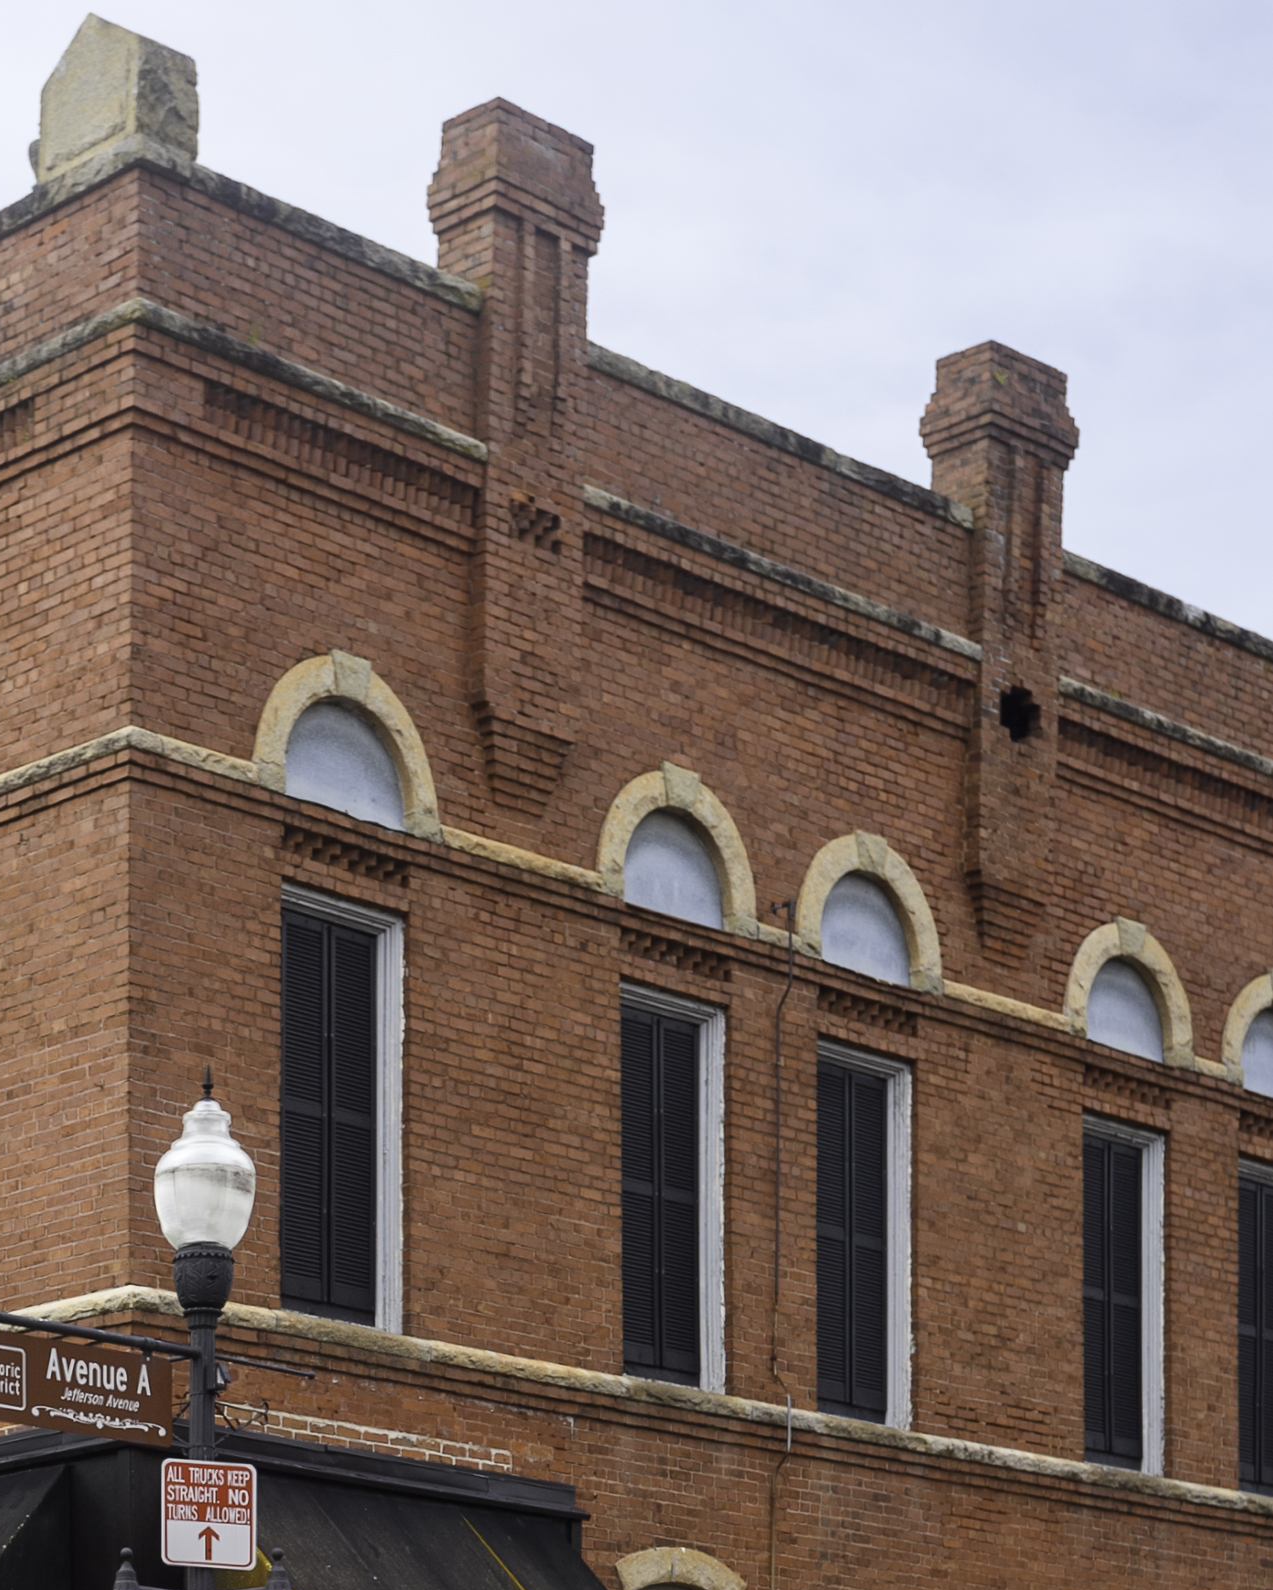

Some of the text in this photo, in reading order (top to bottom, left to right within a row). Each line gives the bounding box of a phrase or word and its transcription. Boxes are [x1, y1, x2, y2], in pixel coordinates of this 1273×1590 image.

[46, 1347, 152, 1396] Avenue A
[60, 1386, 140, 1413] Jefferson Avenue
[167, 1465, 250, 1487] ALL TRUCKS KEEP
[228, 1488, 249, 1506] NO
[167, 1503, 250, 1525] TURNS ALLOWED!
